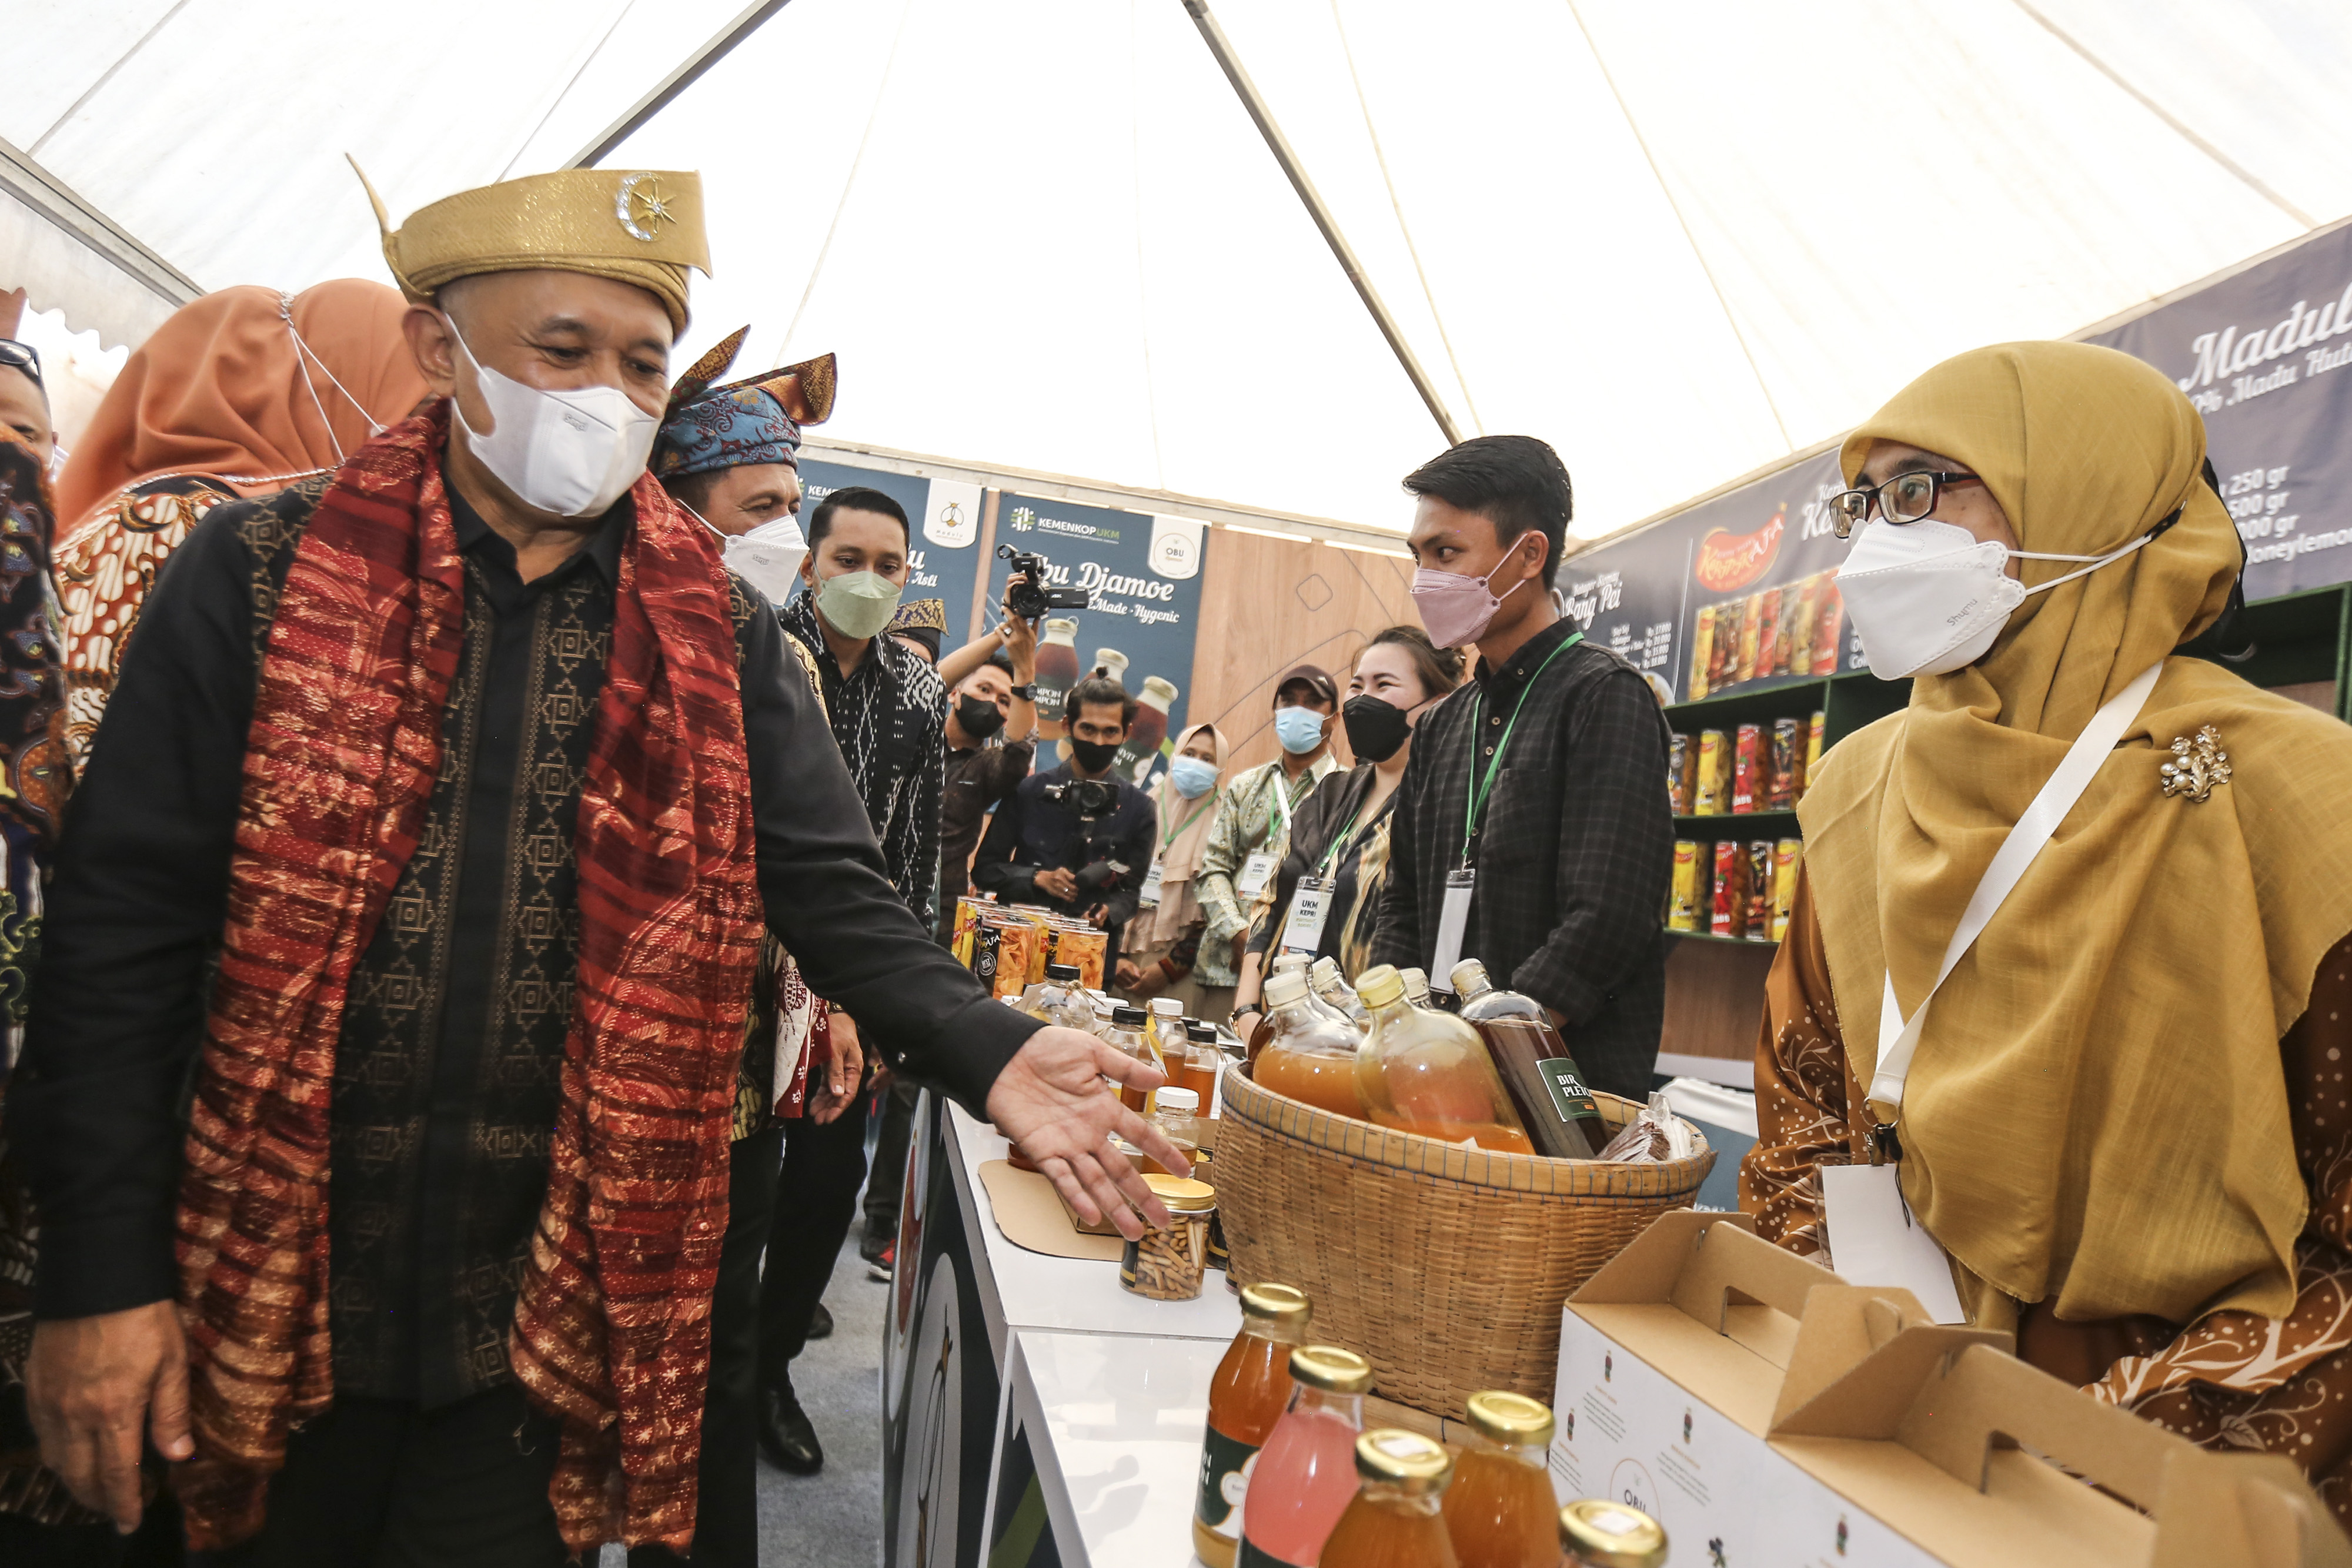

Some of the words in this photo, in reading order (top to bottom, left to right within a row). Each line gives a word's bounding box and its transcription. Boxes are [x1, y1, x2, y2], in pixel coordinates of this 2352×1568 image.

[2229, 468, 2264, 496] 250
[2266, 466, 2290, 490] gr
[2266, 490, 2291, 516] gr
[2274, 514, 2300, 539] gr
[1166, 548, 1185, 557] OBU
[911, 570, 939, 587] Asli
[1302, 900, 1319, 910] UKM
[1299, 909, 1317, 917] KEPRI
[985, 935, 1001, 947] AJA
[1556, 1074, 1582, 1086] BIR
